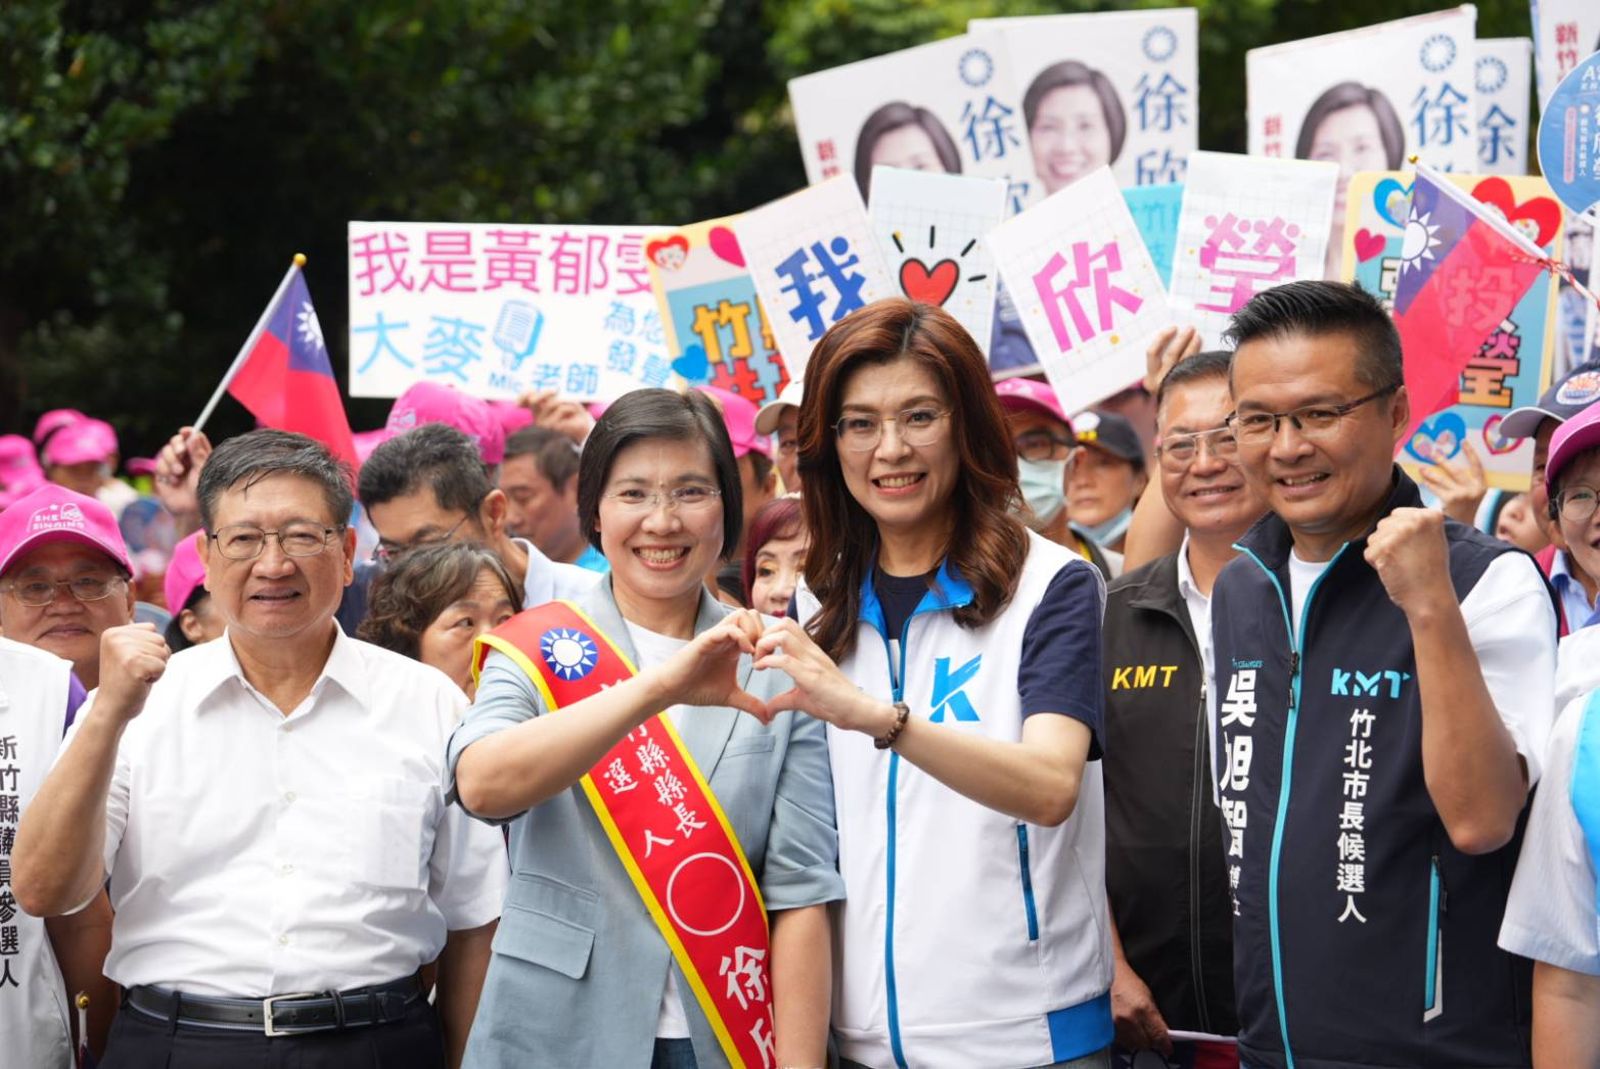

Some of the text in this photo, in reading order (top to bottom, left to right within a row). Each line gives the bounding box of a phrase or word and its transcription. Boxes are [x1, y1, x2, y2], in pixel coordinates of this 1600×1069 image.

[1410, 83, 1470, 172] 徐
[774, 236, 867, 341] 我
[1031, 241, 1144, 353] 欣
[1194, 212, 1300, 314] 瑩
[353, 311, 486, 382] 大麥
[928, 654, 983, 723] K
[1112, 665, 1179, 690] KMT
[1330, 668, 1411, 699] KMT
[1336, 709, 1377, 924] 竹北市長候選人
